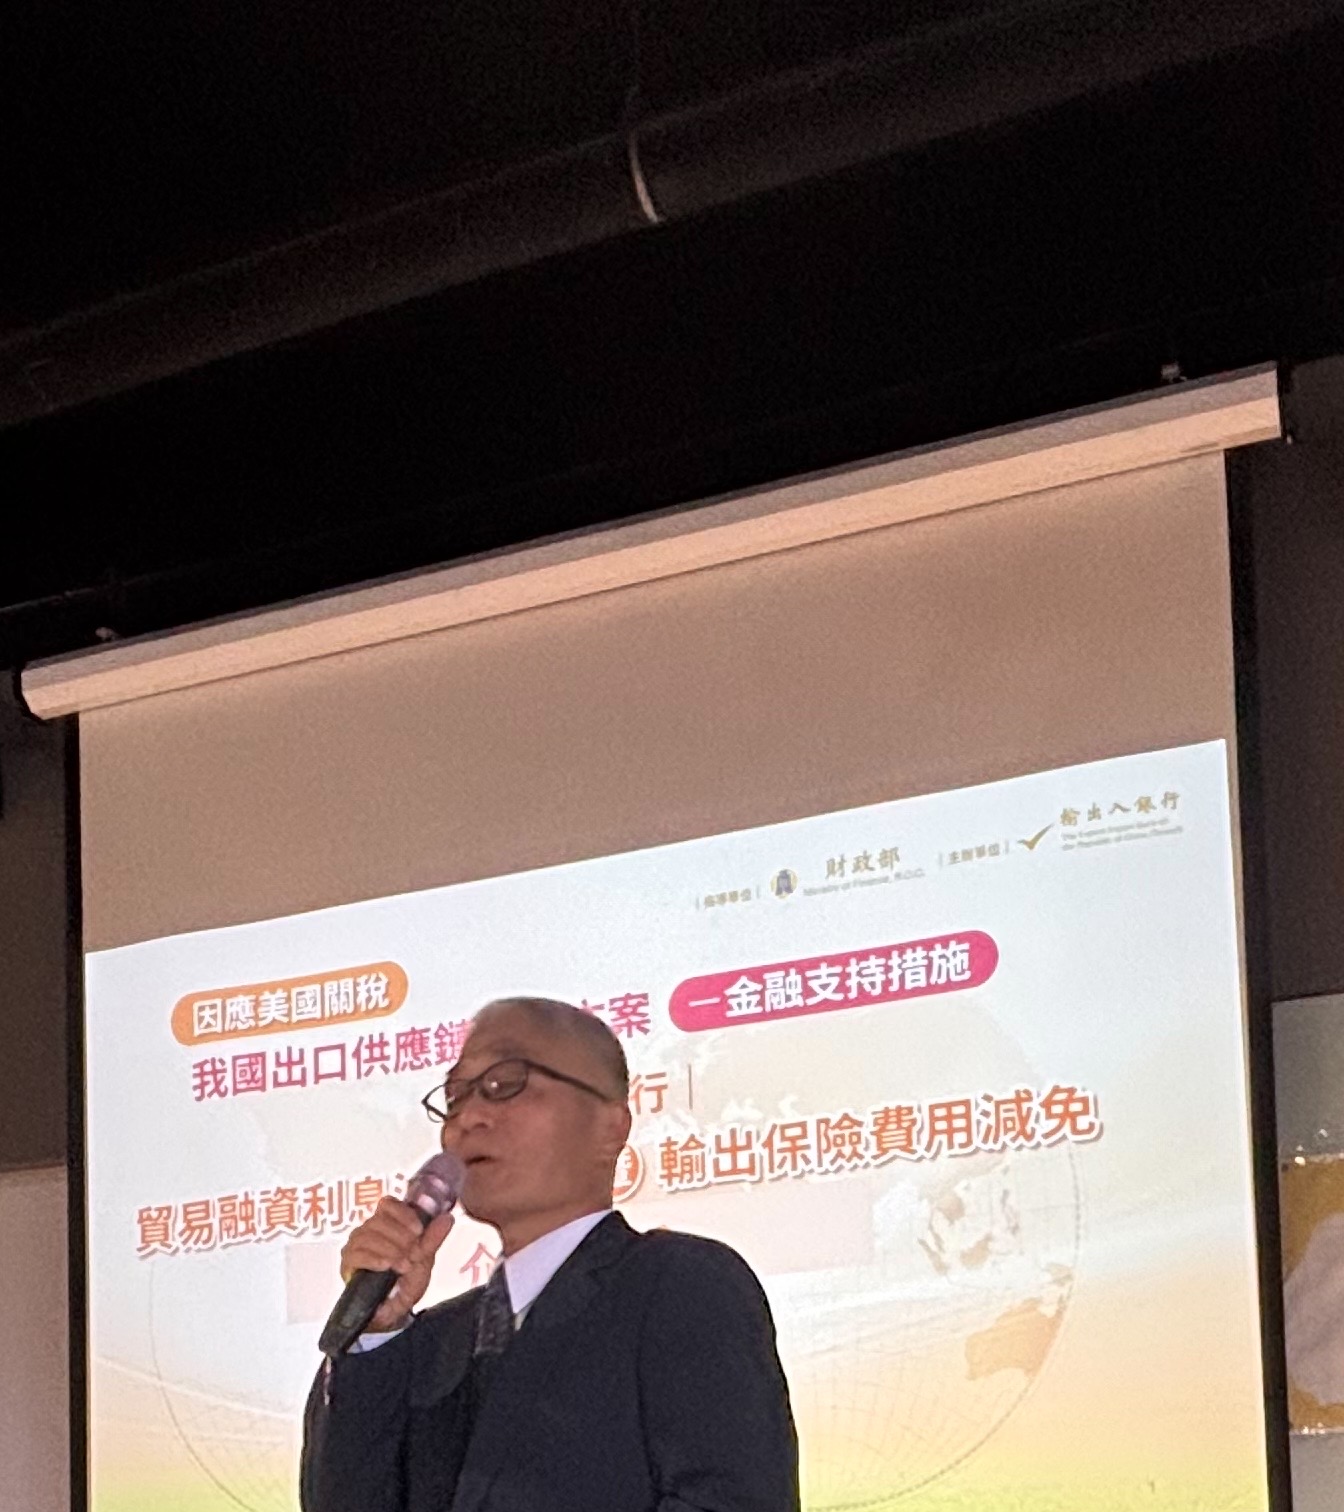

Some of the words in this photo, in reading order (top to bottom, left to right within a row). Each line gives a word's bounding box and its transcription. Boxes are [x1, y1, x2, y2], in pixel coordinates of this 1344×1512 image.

[825, 846, 901, 880] 財政部
[192, 972, 390, 1037] 因應美國關稅
[136, 1173, 408, 1254] 貿易融資利息
[659, 1085, 1097, 1186] 輸出保險費用減免
